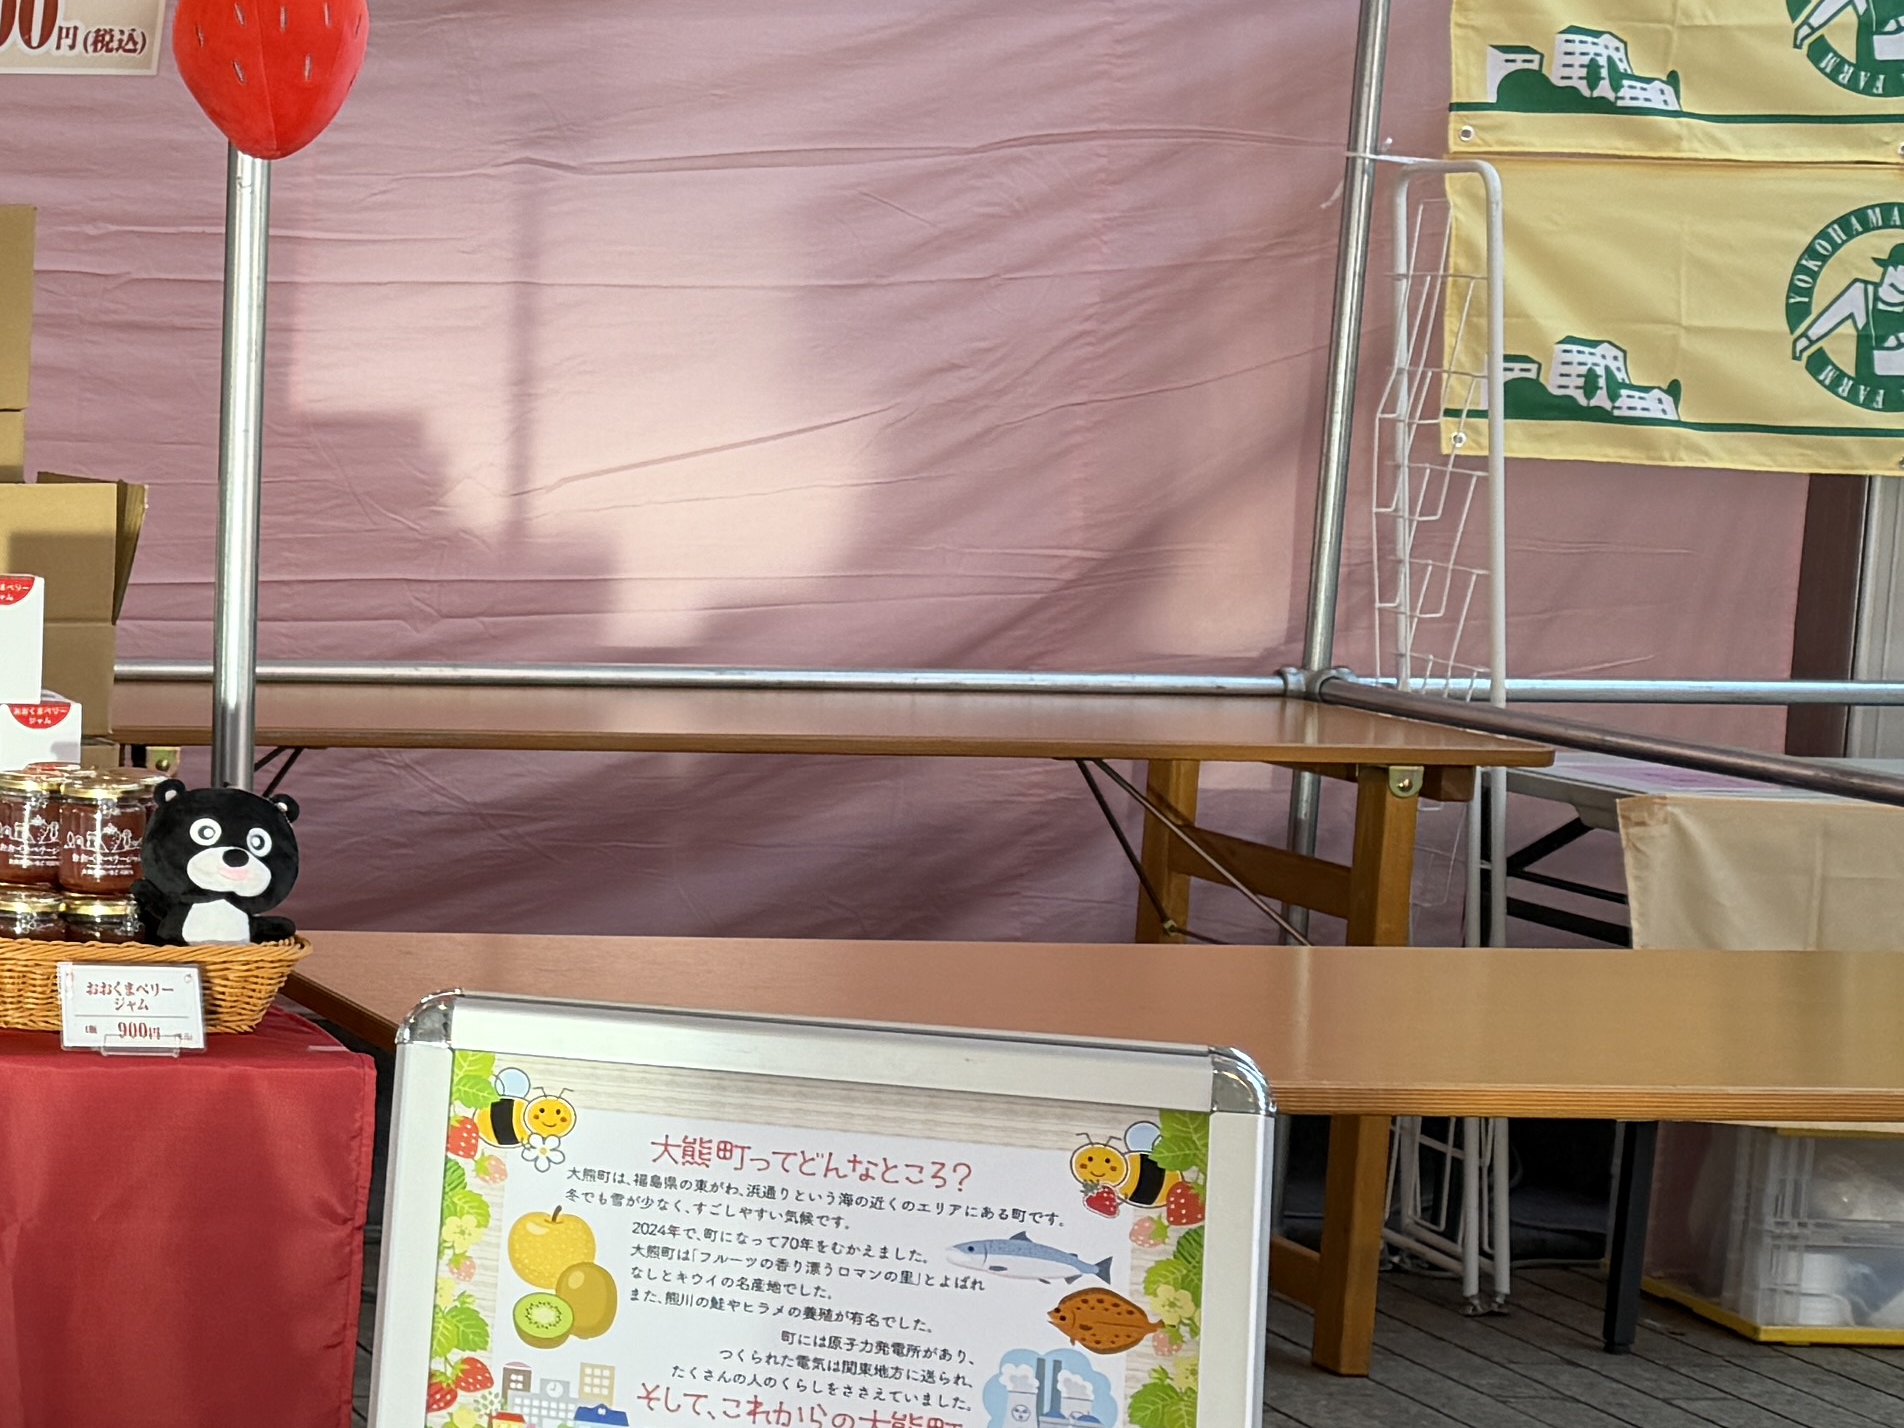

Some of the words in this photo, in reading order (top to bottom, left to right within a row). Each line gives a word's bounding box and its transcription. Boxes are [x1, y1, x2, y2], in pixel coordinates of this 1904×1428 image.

[82, 27, 147, 54] (税込)
[1819, 52, 1885, 94] FARM
[1789, 206, 1901, 303] YOKOHAMA
[1818, 366, 1884, 408] FARM
[86, 981, 174, 996] おおくまベリー
[114, 997, 149, 1011] ジャム
[118, 1022, 160, 1040] 900円
[650, 1134, 972, 1192] 大熊町ってどんなところ？
[565, 1189, 850, 1229] 冬でも雪が少なく、すごしやすい気候です。
[567, 1166, 1064, 1227] 大熊町は、福島県の東がわ、浜通りという海の近くのエリアにある町です。
[632, 1222, 928, 1263] 2024年で、町になって70年をむかえました。
[630, 1265, 832, 1300] なしとキウイの名産地でした。
[629, 1288, 932, 1333] また、熊川の鮭やヒラメの養殖が有名でした。
[781, 1330, 975, 1365] 町には原子力発電所があり、
[720, 1348, 973, 1388] つくられた電気は関東地方に送られ、
[672, 1365, 971, 1412] たくさんの人のくらしをささえていました。
